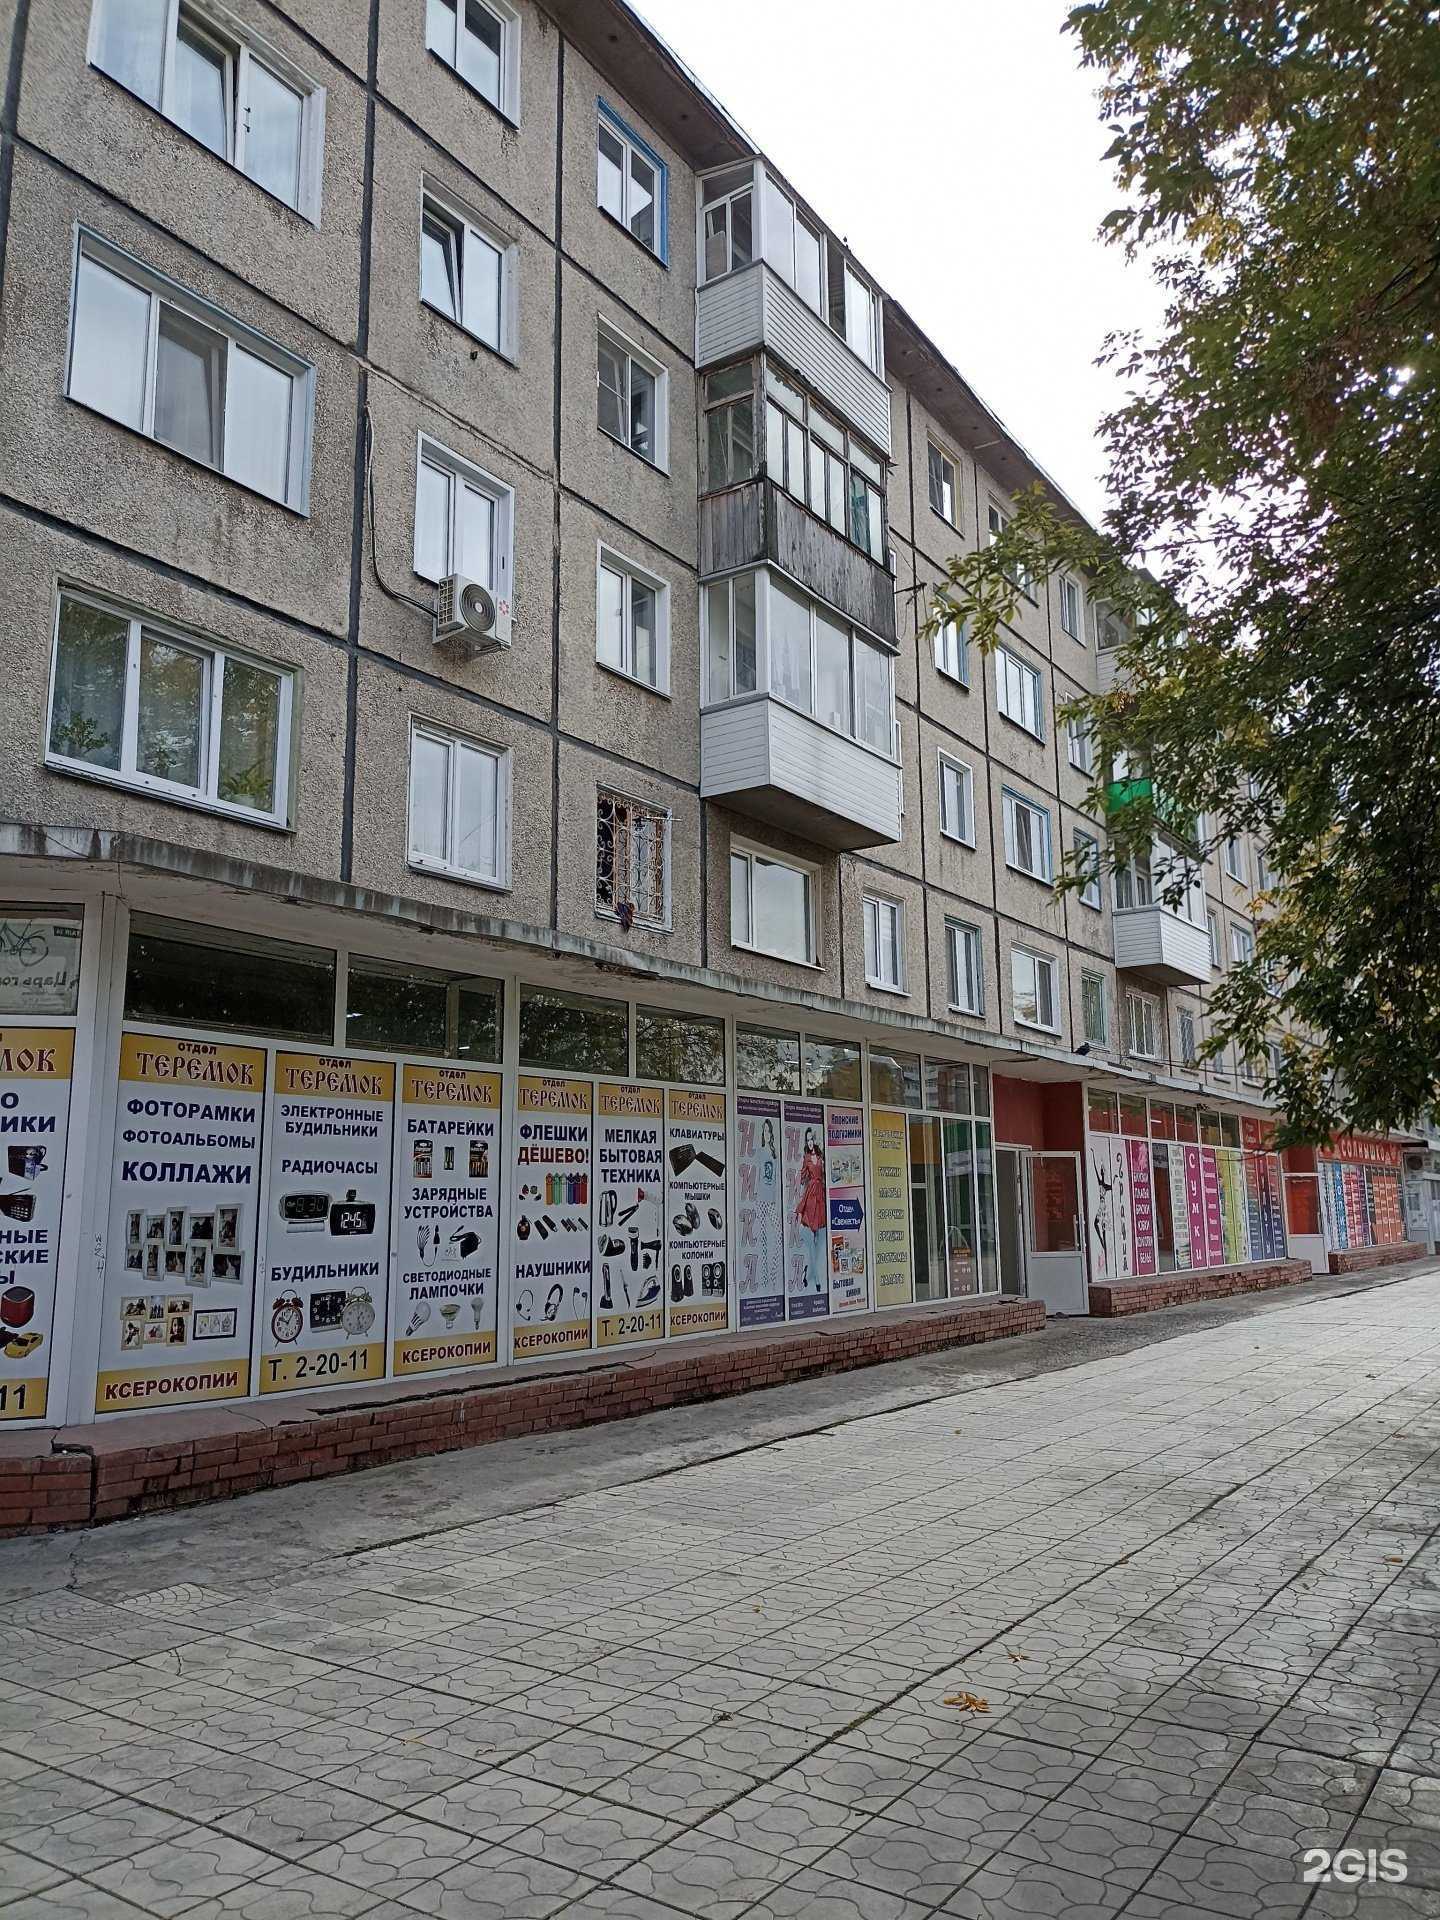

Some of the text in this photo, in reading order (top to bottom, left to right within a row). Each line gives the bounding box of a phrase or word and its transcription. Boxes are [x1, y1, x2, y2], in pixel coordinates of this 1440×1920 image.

[136, 1052, 255, 1086] ТЕРЕМОК
[286, 1068, 382, 1095] ТЕРЕМОК
[411, 1079, 492, 1103] ТЕРЕМОК
[519, 1088, 588, 1110] ТЕРЕМОК
[601, 1094, 661, 1114] ТЕРЕМОК
[127, 1098, 256, 1123] ФОТОРАМКИ
[280, 1104, 384, 1122] ЭЛЕКТРОННЫЕ
[671, 1100, 724, 1120] ТЕРЕМОК
[285, 1121, 378, 1138] БУДИЛЬНИКИ
[407, 1118, 494, 1137] БАТАРЕЙКИ
[519, 1123, 588, 1142] ФЛЕШКИ
[604, 1128, 657, 1144] МЕЛКАЯ
[669, 1127, 725, 1141] КЛАВИАТУРЫ
[122, 1129, 256, 1149] ФОТОАЛЬБОМЫ
[517, 1143, 589, 1166] ДЁШЕВО!
[599, 1148, 662, 1164] БЫТОВАЯ
[122, 1160, 252, 1185] КОЛЛАЖИ
[281, 1159, 378, 1175] РАДИОЧАСЫ
[601, 1168, 661, 1183] ТЕХНИКА
[412, 1187, 487, 1203] ЗАРЯДНЫЕ
[669, 1181, 726, 1191] КОМПЬЮТЕРНЫЕ
[684, 1192, 711, 1201] МЫШКИ
[404, 1203, 493, 1219] УСТРОЙСТВА
[669, 1239, 726, 1249] КОМПЬЮТЕРНЫЕ
[0, 1249, 49, 1264] КИЕ
[682, 1250, 714, 1260] КОЛОНКИ
[271, 1262, 379, 1282] БУДИЛЬНИКИ
[402, 1268, 492, 1284] СВЕТОДИОДНЫЕ
[515, 1260, 591, 1279] НАУШНИКИ
[409, 1283, 484, 1300] ЛАМПОЧКИ
[601, 1313, 662, 1337] Т. 2-20-11
[670, 1311, 726, 1326] КСЕРОКОПИИ
[514, 1328, 588, 1349] КСЕРОКОПИИ
[402, 1341, 491, 1364] КСЕРОКОПИИ
[268, 1348, 368, 1382] Т. 2-20-11
[105, 1371, 239, 1400] КСЕРОКОПИИ
